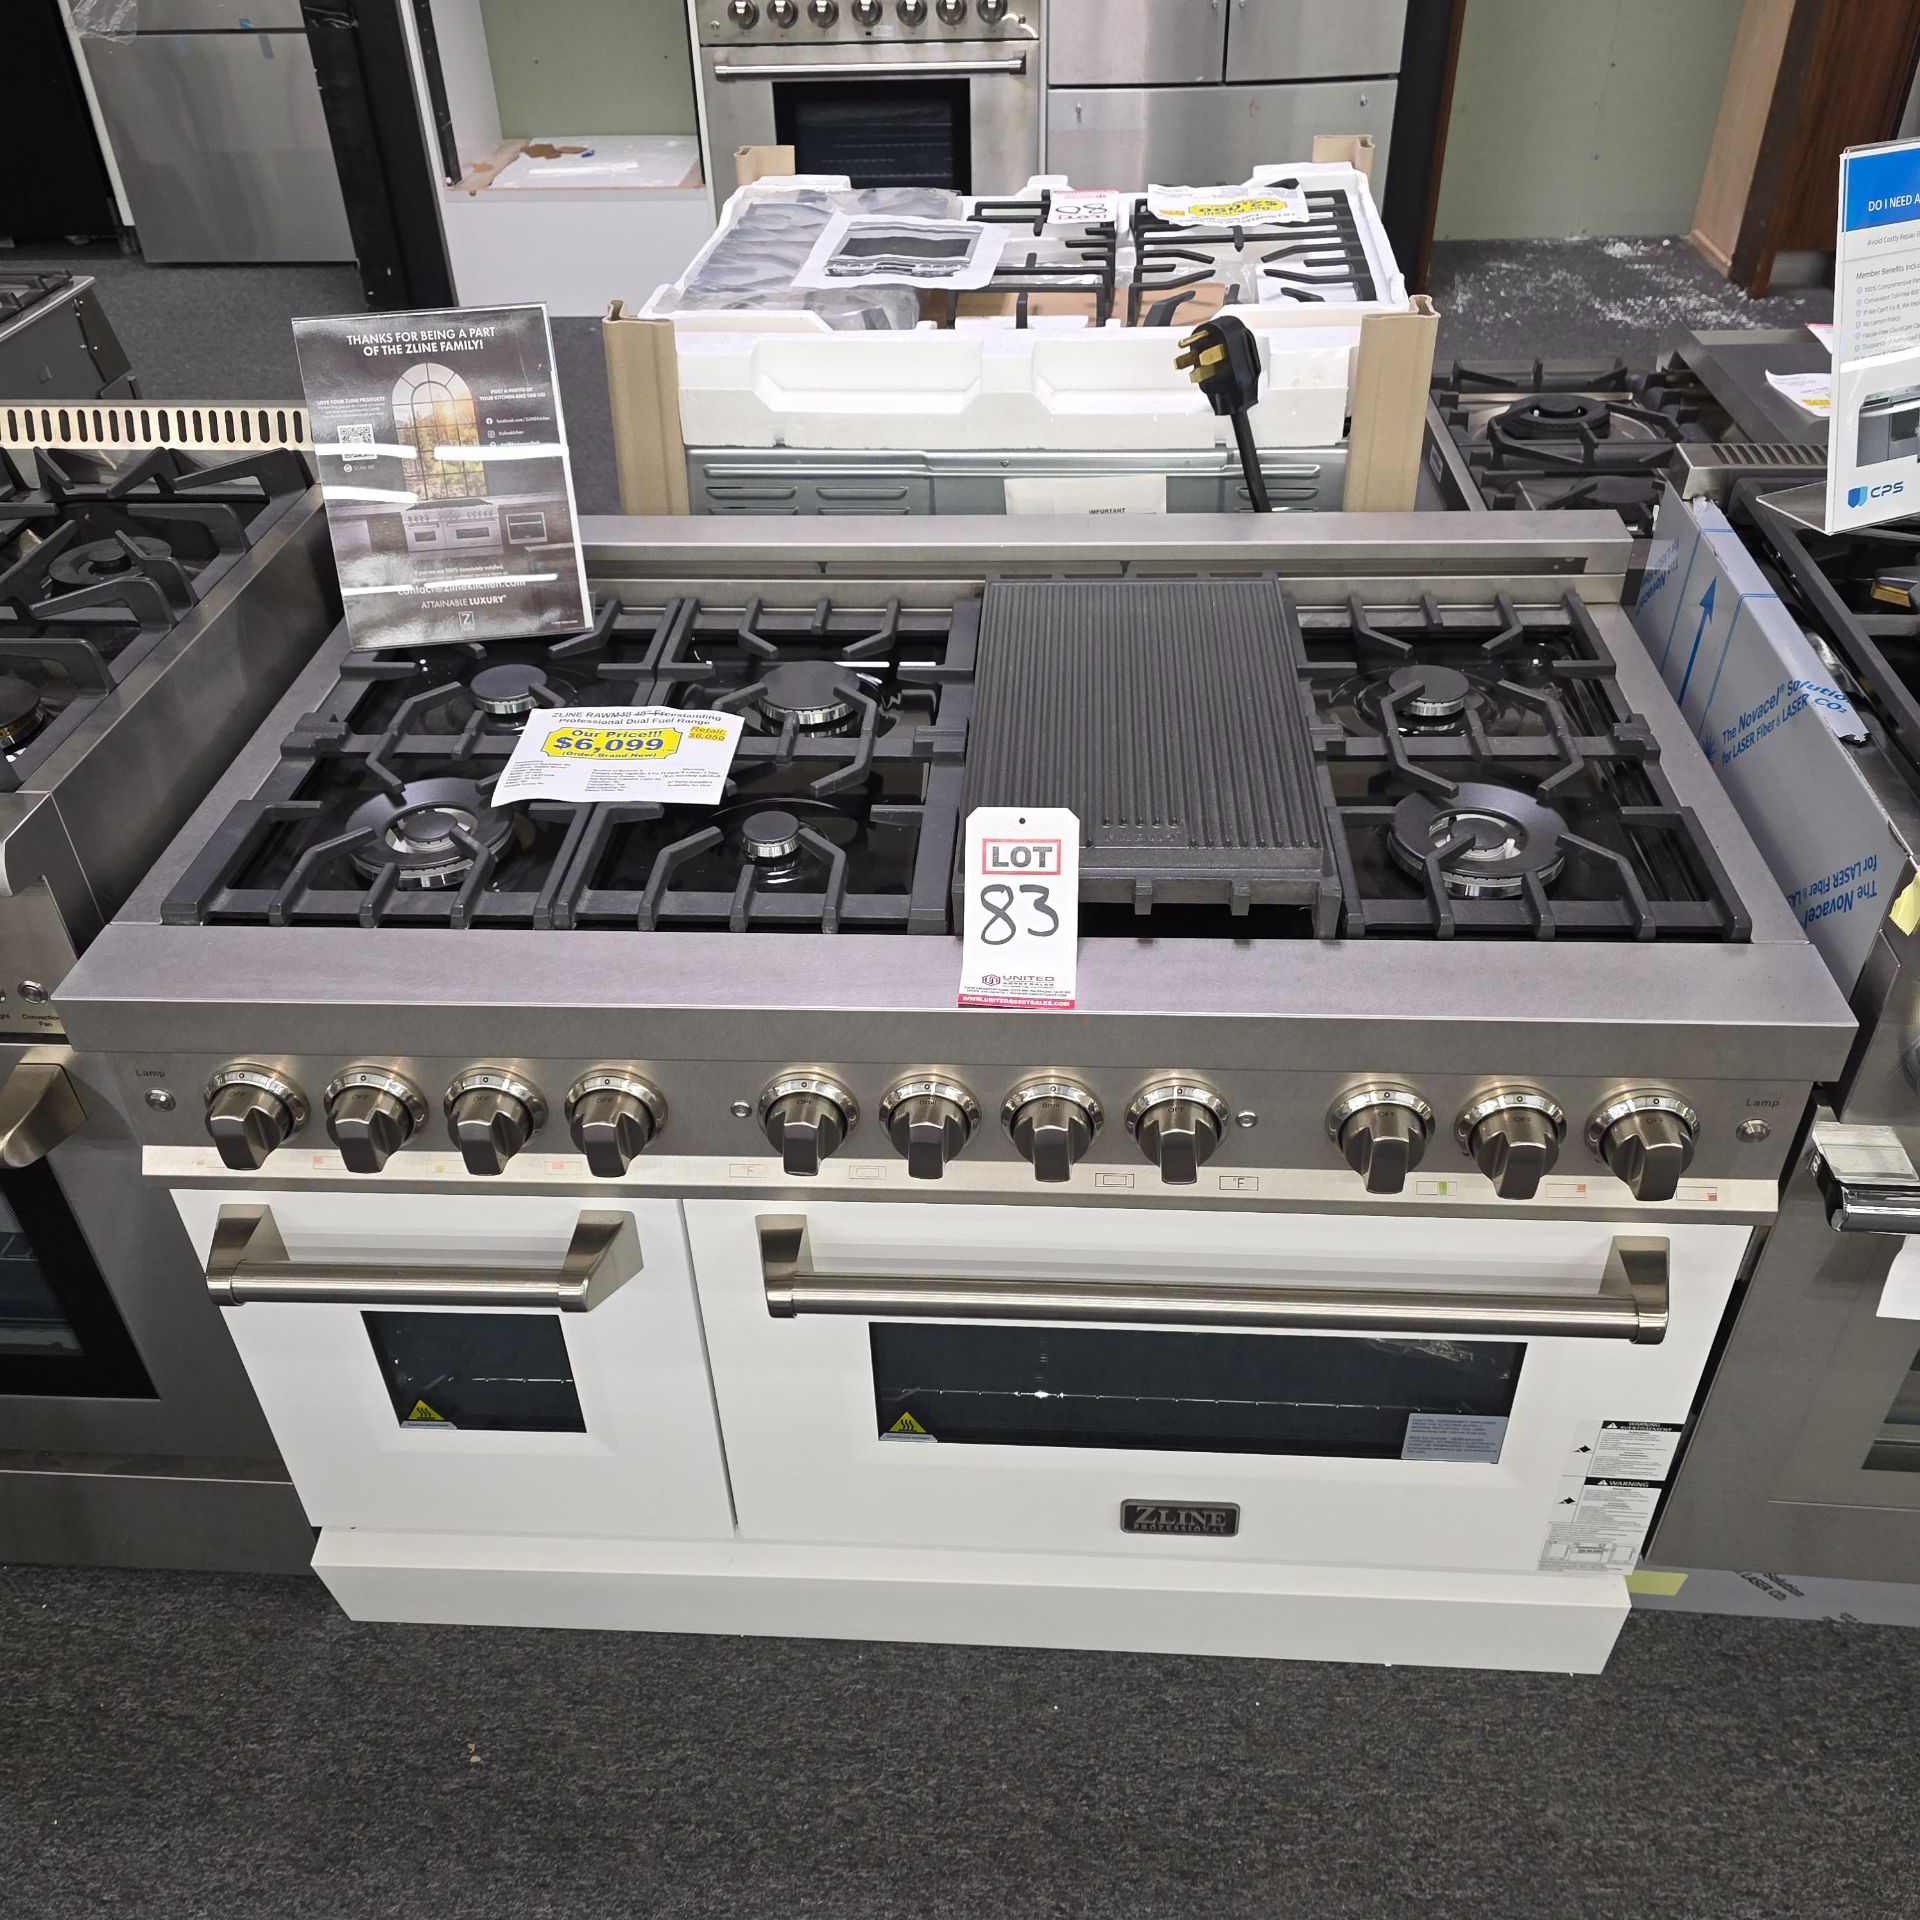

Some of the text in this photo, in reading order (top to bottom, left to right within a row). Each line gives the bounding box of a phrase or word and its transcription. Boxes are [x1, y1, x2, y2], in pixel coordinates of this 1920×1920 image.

[1054, 202, 1108, 215] 80
[1868, 199, 1882, 212] DO
[1884, 198, 1888, 209] I
[1889, 194, 1912, 209] NEED
[1867, 238, 1882, 246] Avoid
[1883, 235, 1899, 243] Costly
[1900, 232, 1915, 241] Repair
[1856, 270, 1880, 279] Member
[1882, 264, 1904, 275] Benefits
[346, 326, 496, 345] THANKS FOR BEING A PART
[363, 339, 484, 357] OF THE ZLINE FAMILY!
[1870, 481, 1904, 498] CPS
[421, 598, 468, 609] ATTAINABLE
[653, 709, 722, 722] Freestanding
[677, 718, 711, 726] Range
[572, 726, 727, 738] Our Price!!! Retail:
[1722, 749, 1732, 766] for
[1733, 732, 1755, 758] LASER
[1757, 719, 1775, 741] Fiber
[1776, 718, 1781, 727] &
[1782, 693, 1810, 722] LASER
[1722, 727, 1736, 744] The
[553, 736, 664, 753] $6,099
[992, 846, 1053, 868] LOT
[1863, 854, 1877, 872] for
[1833, 862, 1861, 888] LASER
[1809, 876, 1830, 896] Fiber
[1803, 880, 1877, 929] The Novacel
[980, 884, 1059, 945] 83
[962, 996, 1070, 1007] WWW.UNITEDASSETSALES.COM
[135, 1069, 166, 1078] Lamp
[1746, 1098, 1779, 1108] Lamp
[1610, 1480, 1649, 1488] WARNING
[1135, 1506, 1226, 1526] ZLINE
[1134, 1523, 1225, 1533] PROFESSIONAL
